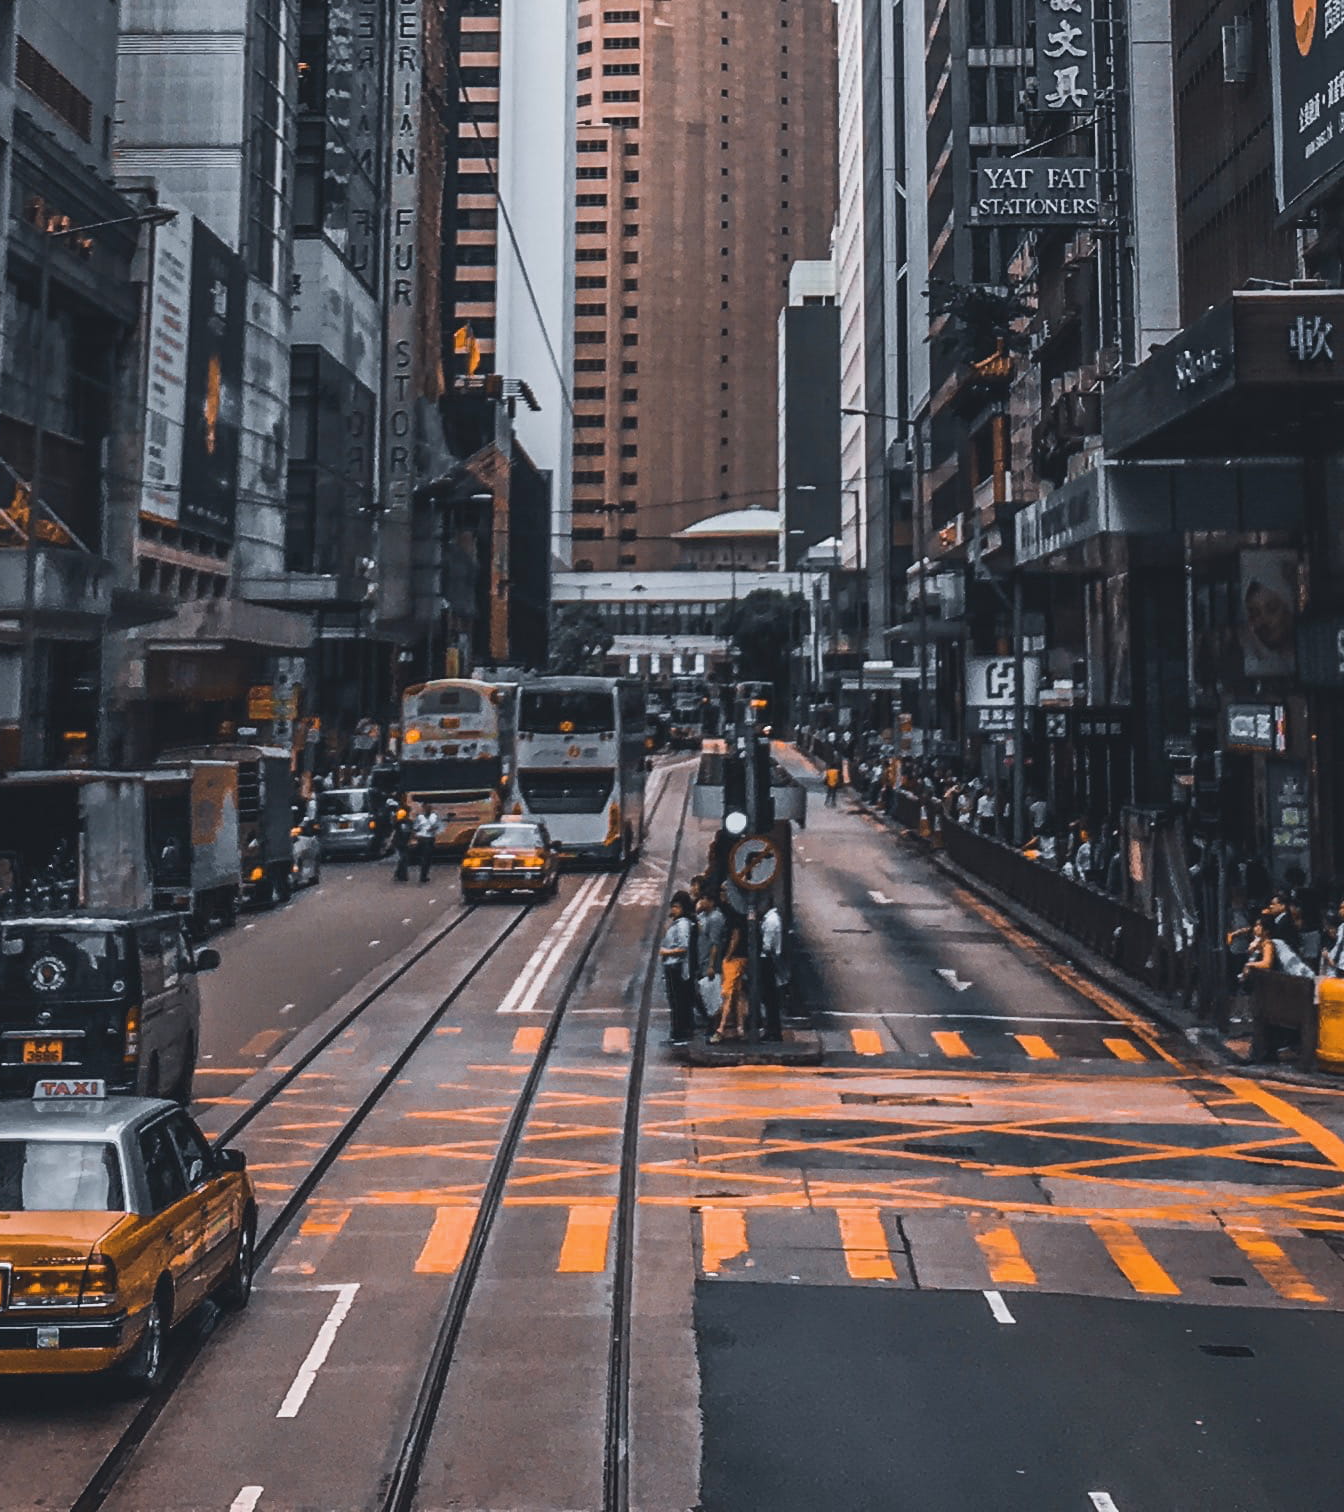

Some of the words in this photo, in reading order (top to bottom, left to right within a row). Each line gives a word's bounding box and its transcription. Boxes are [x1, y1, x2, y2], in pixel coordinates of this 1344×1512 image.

[983, 168, 1034, 190] YAT
[1047, 168, 1091, 190] FAT
[979, 197, 1099, 216] STATIONERS
[393, 208, 413, 306] FUR
[390, 340, 411, 508] STORE
[41, 1081, 98, 1096] TAXI
